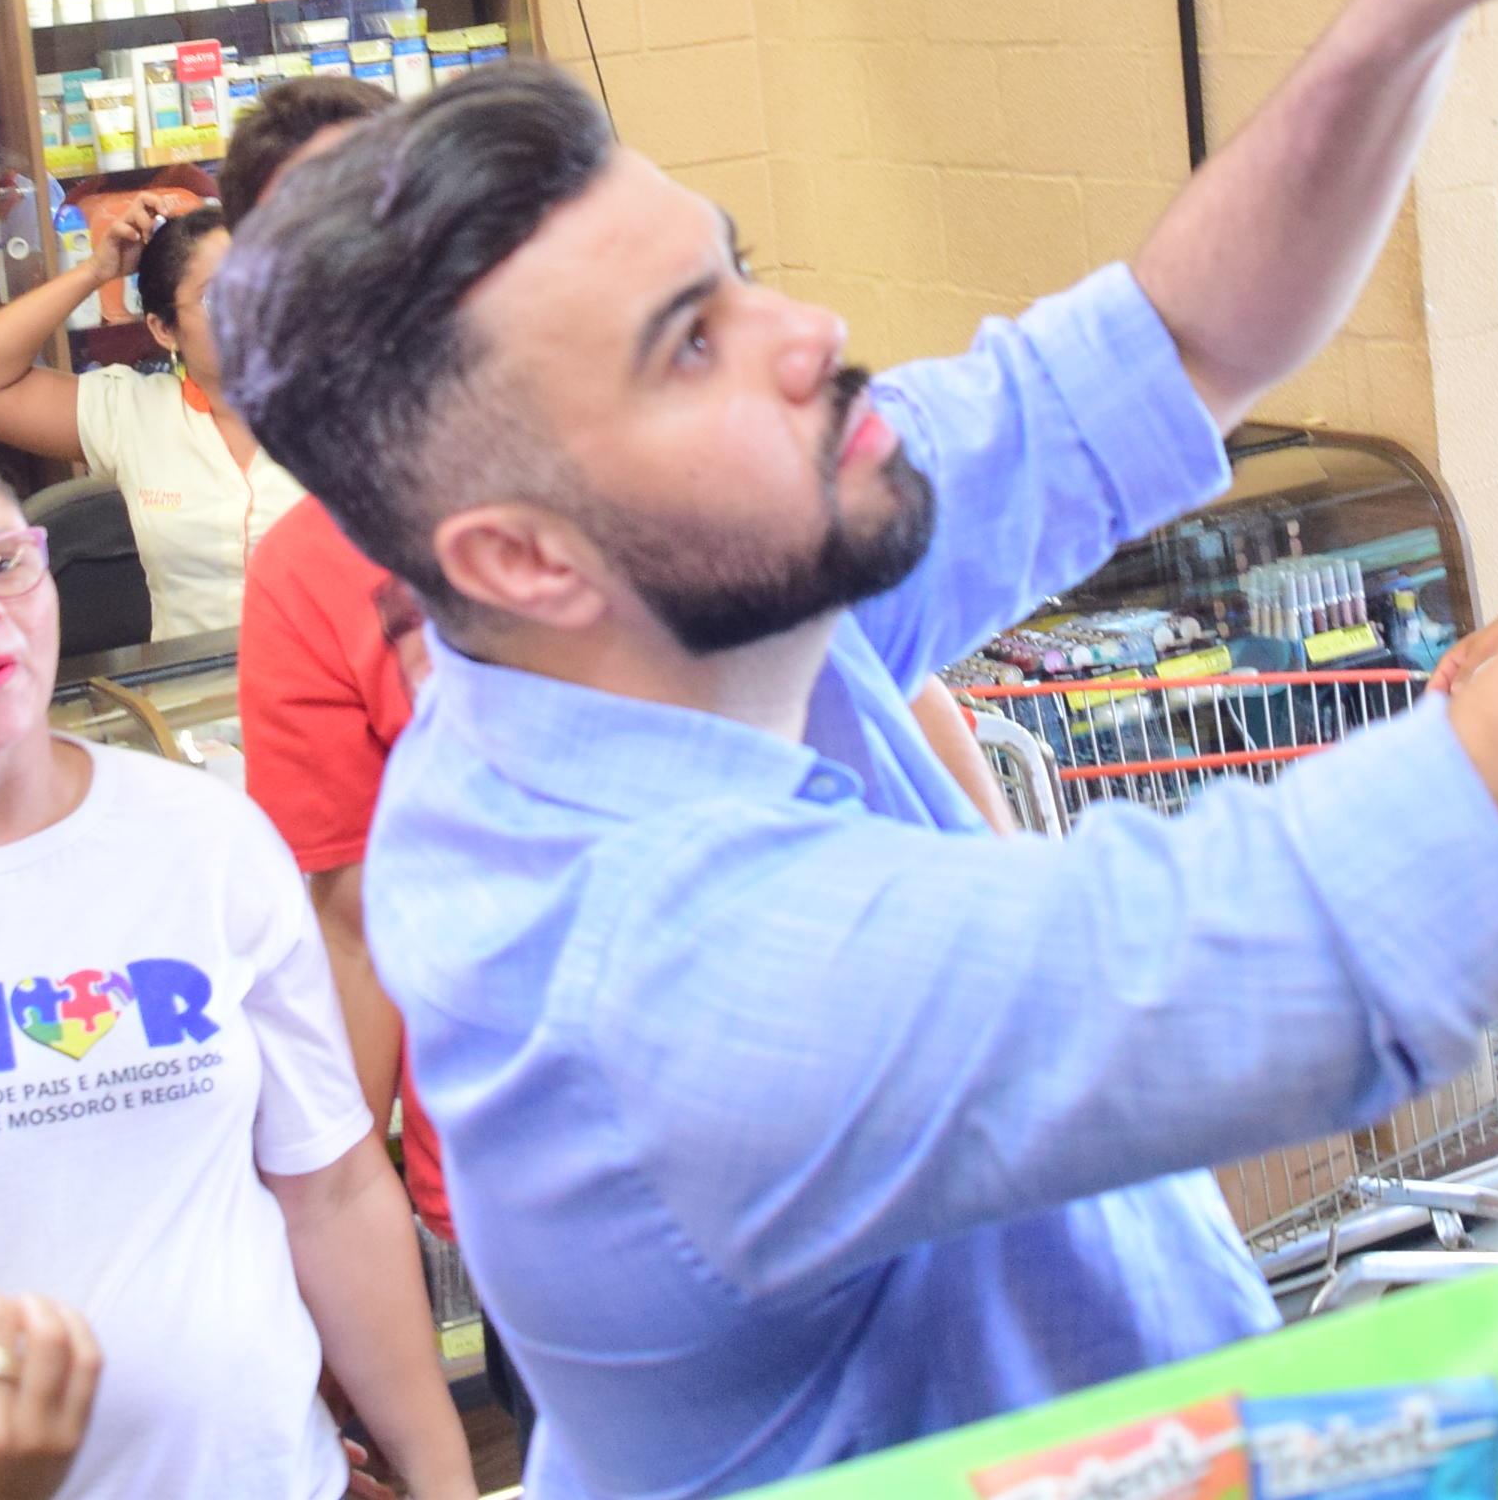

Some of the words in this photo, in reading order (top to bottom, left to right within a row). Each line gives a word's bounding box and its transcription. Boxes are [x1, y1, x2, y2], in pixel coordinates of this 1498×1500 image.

[24, 1077, 72, 1101] PAIS
[79, 1074, 89, 1091] E
[95, 1061, 182, 1089] AMIGOS
[187, 1051, 224, 1073] DOS
[8, 1092, 118, 1131] MOSSORÓ
[123, 1093, 134, 1109] E
[140, 1075, 215, 1107] REGIÃO
